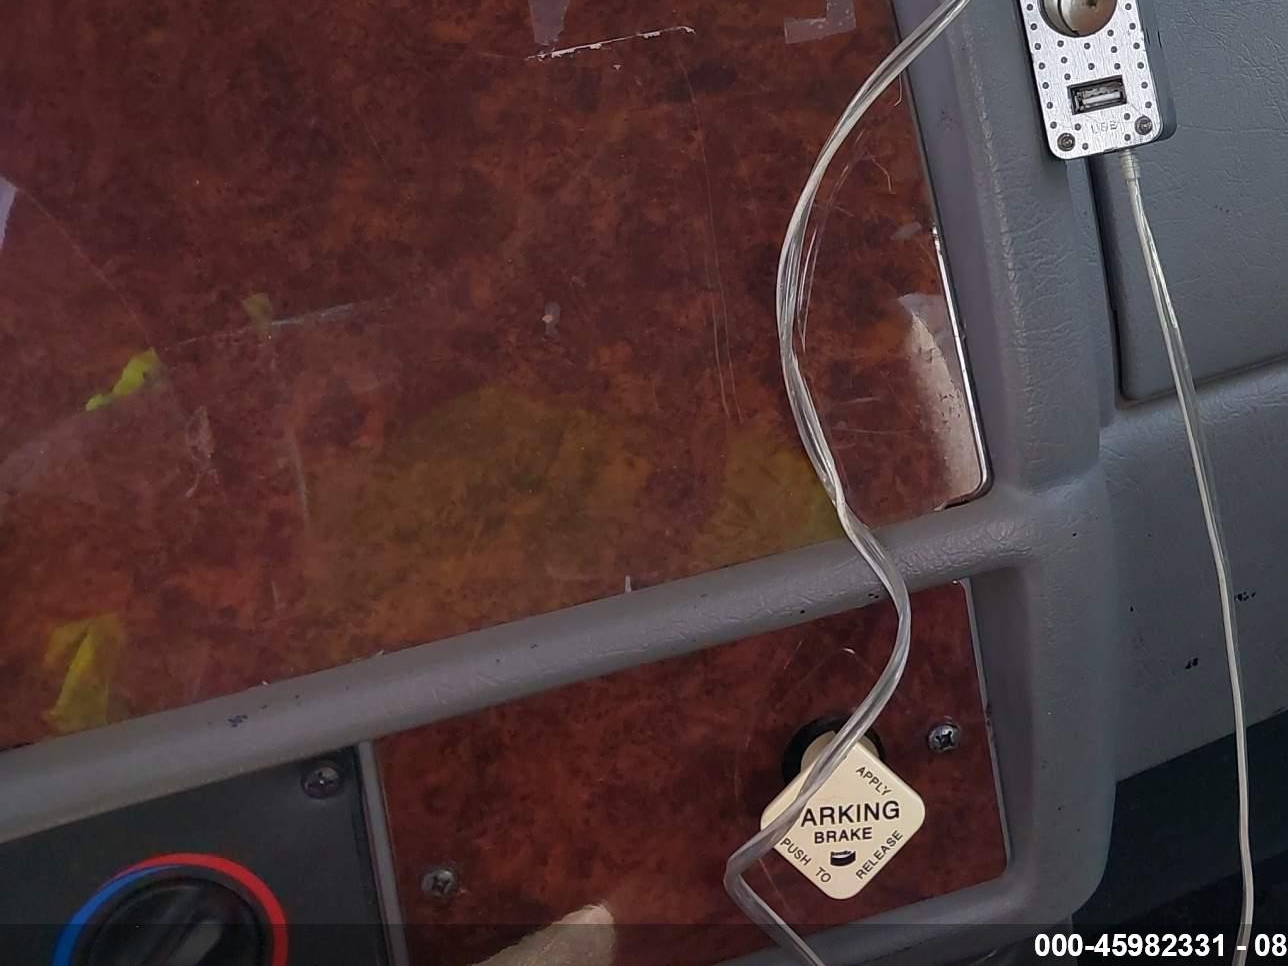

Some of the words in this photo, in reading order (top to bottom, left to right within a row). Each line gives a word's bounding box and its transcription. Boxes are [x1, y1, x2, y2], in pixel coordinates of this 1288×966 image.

[855, 766, 892, 796] APPLY
[800, 800, 900, 827] ARKING
[814, 826, 873, 845] BRAKE
[780, 837, 812, 866] PUSH
[815, 867, 832, 883] TO
[856, 830, 903, 880] RELEASE
